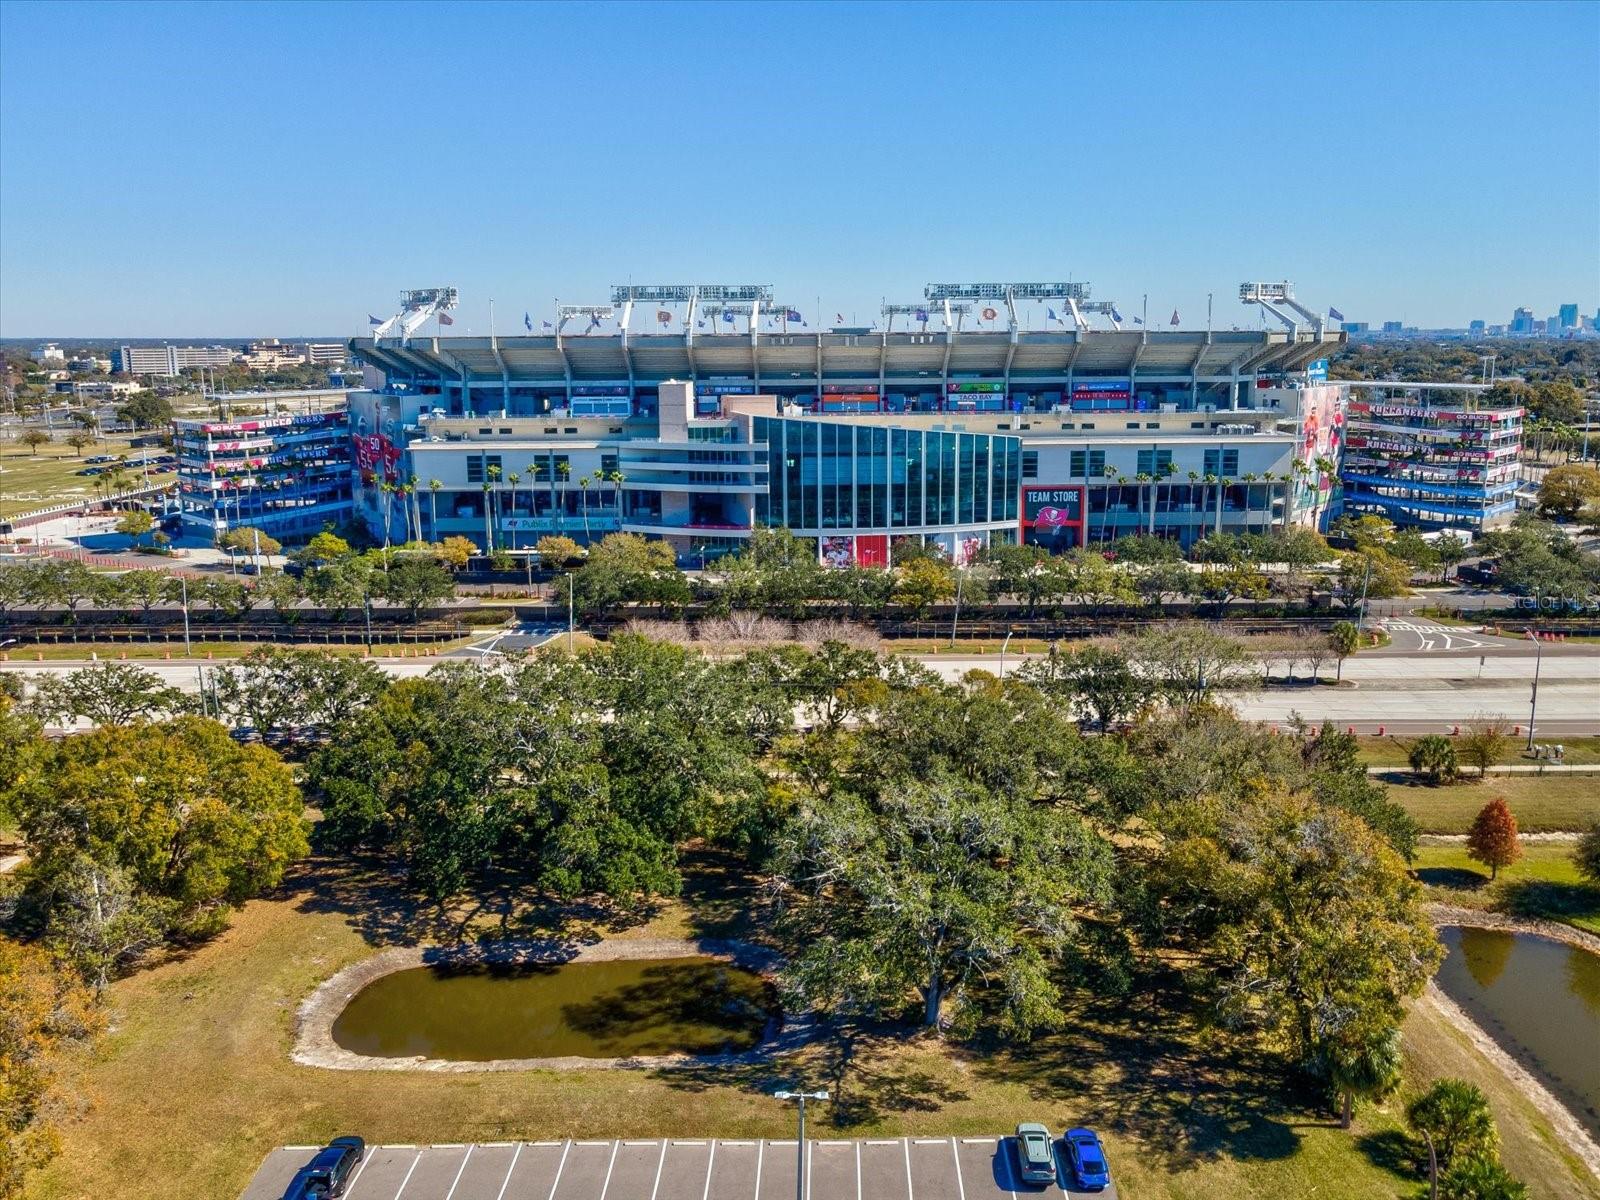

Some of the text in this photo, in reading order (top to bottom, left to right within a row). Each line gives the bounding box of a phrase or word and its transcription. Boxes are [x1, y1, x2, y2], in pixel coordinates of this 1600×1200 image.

[370, 437, 380, 451] 50
[360, 450, 373, 470] 55
[1028, 491, 1079, 502] TEAM STORE
[522, 519, 549, 528] Publix
